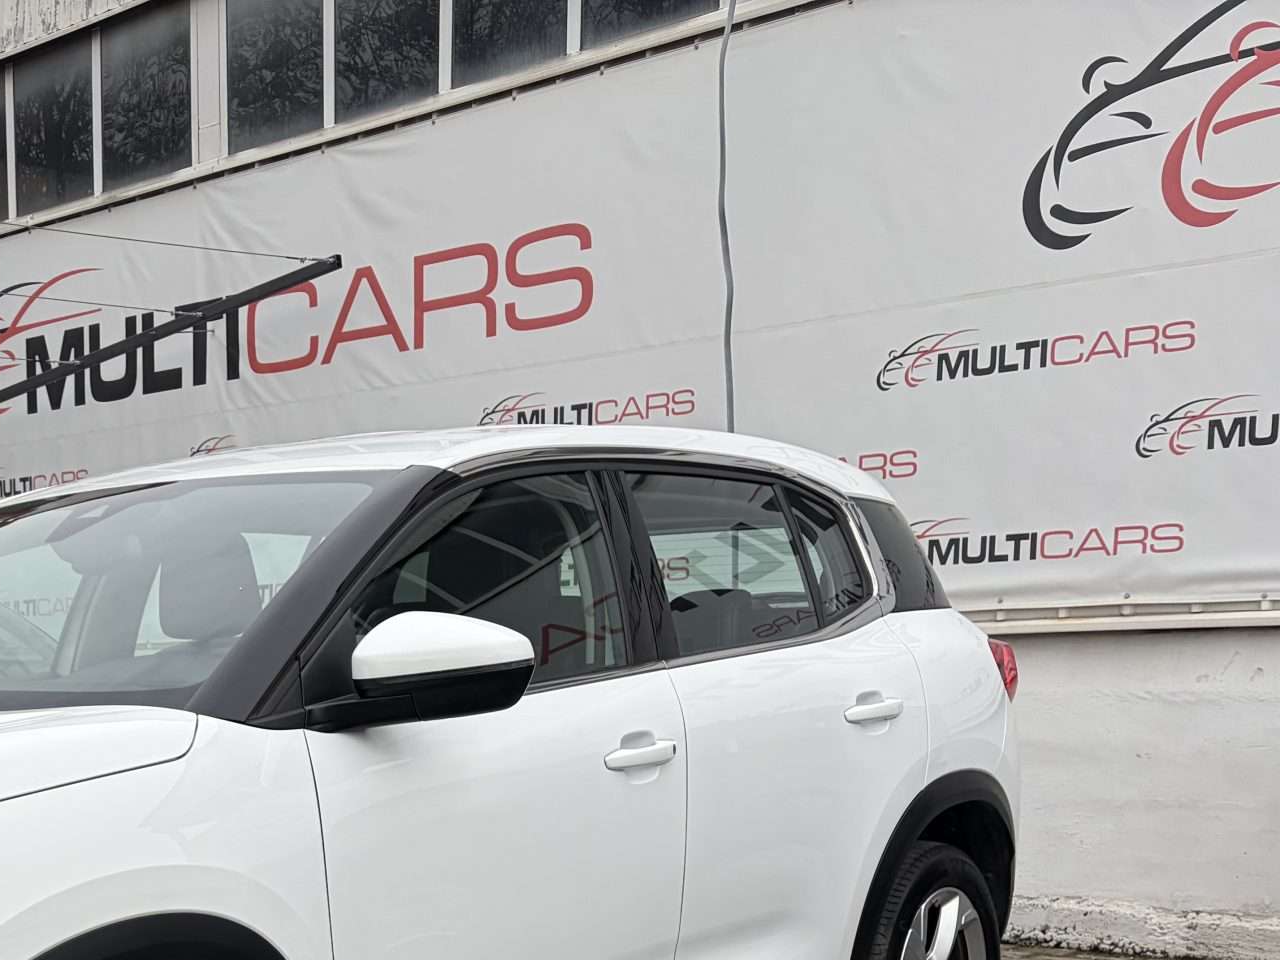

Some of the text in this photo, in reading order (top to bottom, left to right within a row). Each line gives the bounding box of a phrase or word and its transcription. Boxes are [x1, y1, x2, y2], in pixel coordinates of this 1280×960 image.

[26, 223, 594, 414] MULTICARS
[936, 320, 1196, 381] MULTICARS
[928, 523, 1185, 566] MULTICARS
